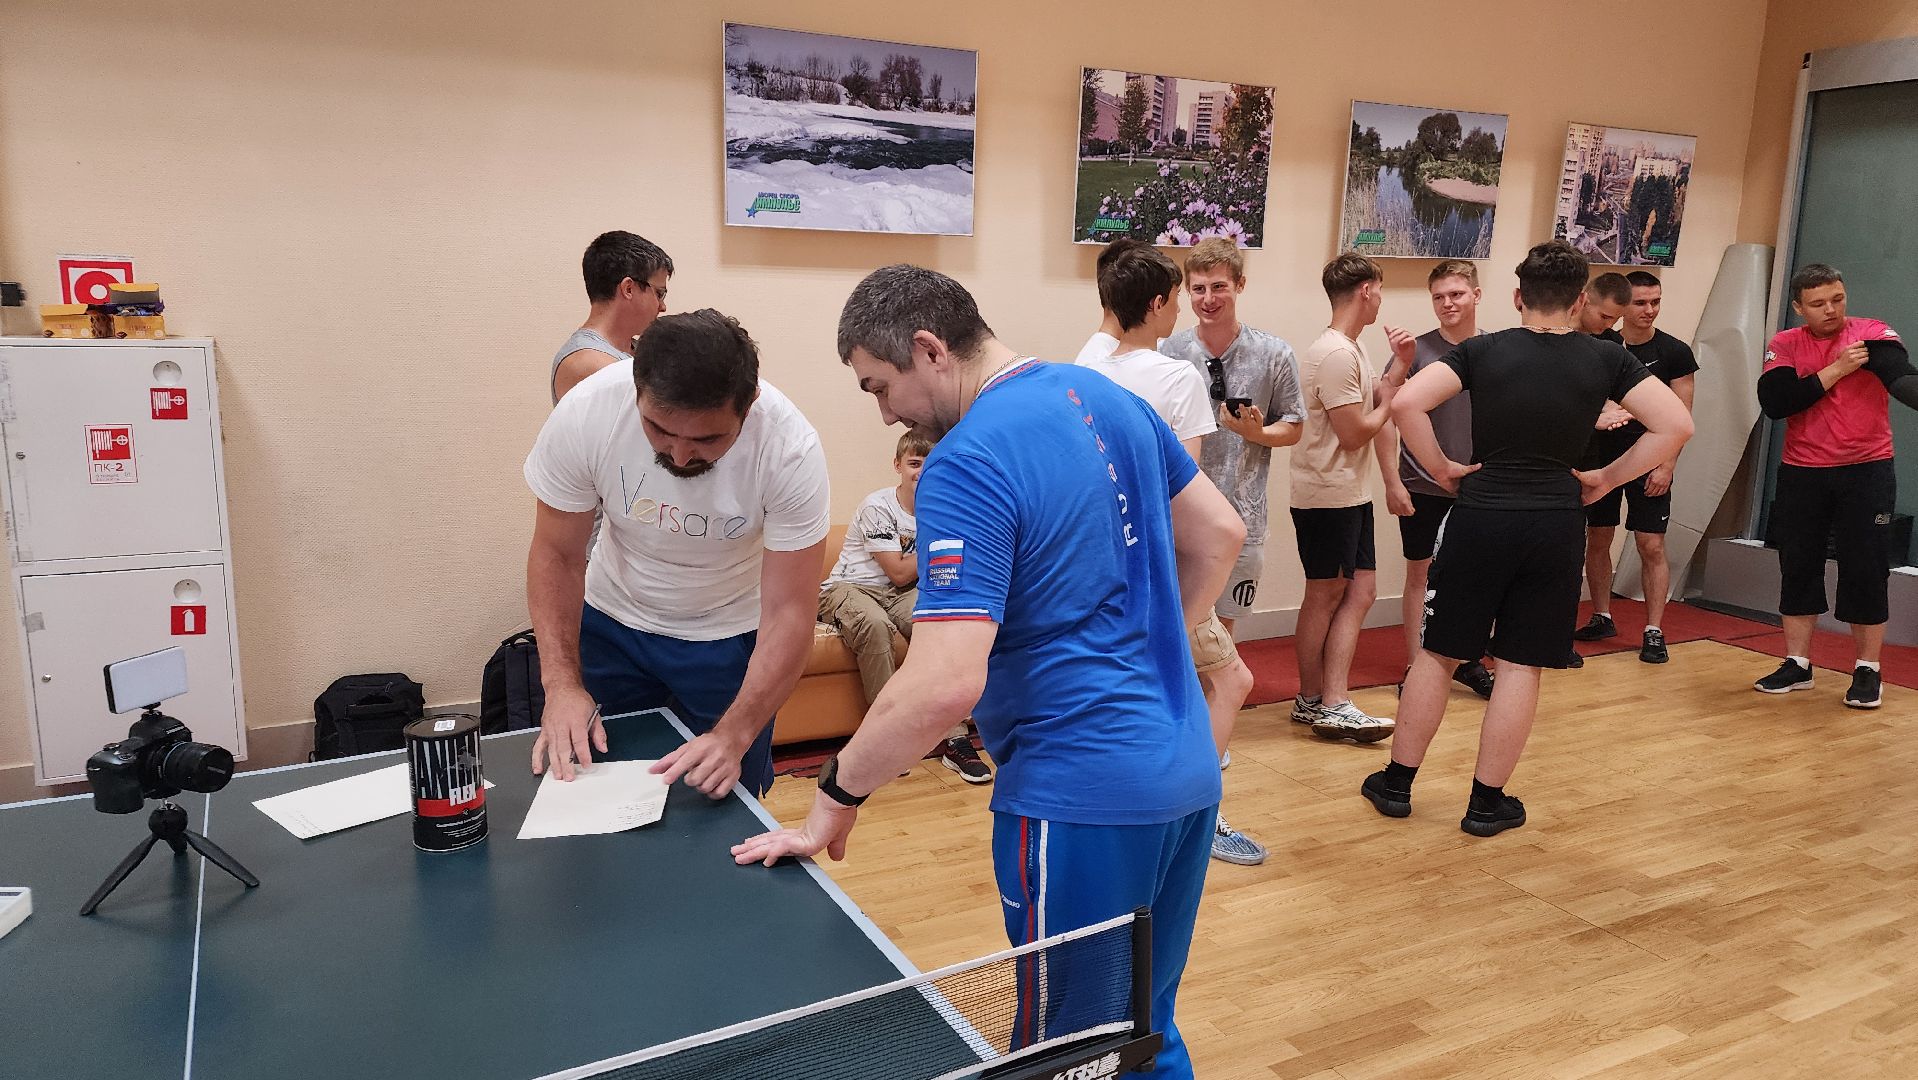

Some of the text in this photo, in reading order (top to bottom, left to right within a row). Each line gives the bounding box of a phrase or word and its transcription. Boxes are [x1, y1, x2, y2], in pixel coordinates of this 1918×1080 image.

[1096, 218, 1130, 229] ИМПУЛЬС
[94, 462, 124, 472] ПК-2
[620, 465, 747, 541] Versace
[929, 566, 957, 575] RUSSIAN
[448, 782, 477, 807] FLEX
